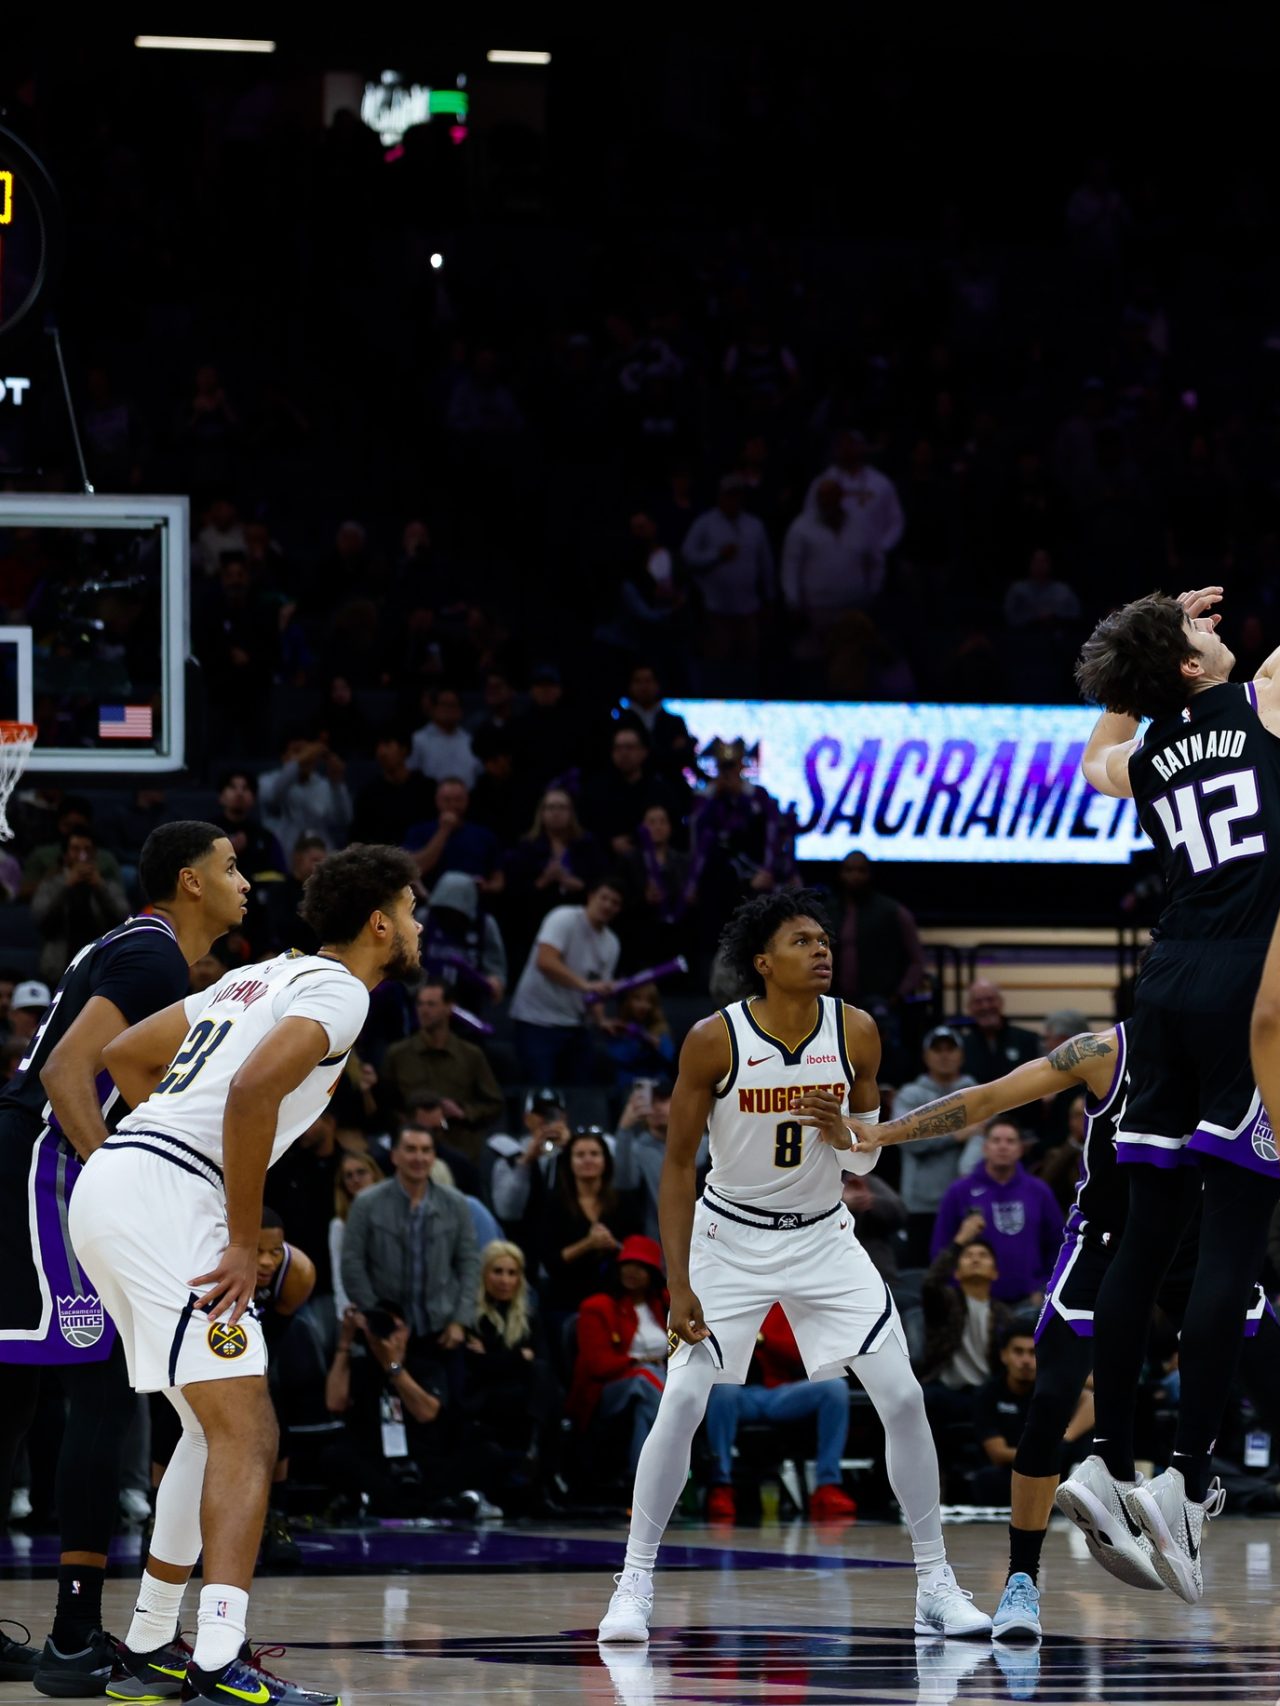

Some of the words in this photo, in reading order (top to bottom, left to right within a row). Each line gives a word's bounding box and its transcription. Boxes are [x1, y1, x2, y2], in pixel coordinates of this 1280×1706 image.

[1151, 730, 1247, 782] RAYNAUD
[1150, 766, 1267, 876] 42
[149, 1017, 236, 1096] 23
[806, 1054, 837, 1065] ibotta
[738, 1083, 846, 1114] NUGGS
[774, 1120, 803, 1168] 8
[60, 1316, 103, 1328] KINGS
